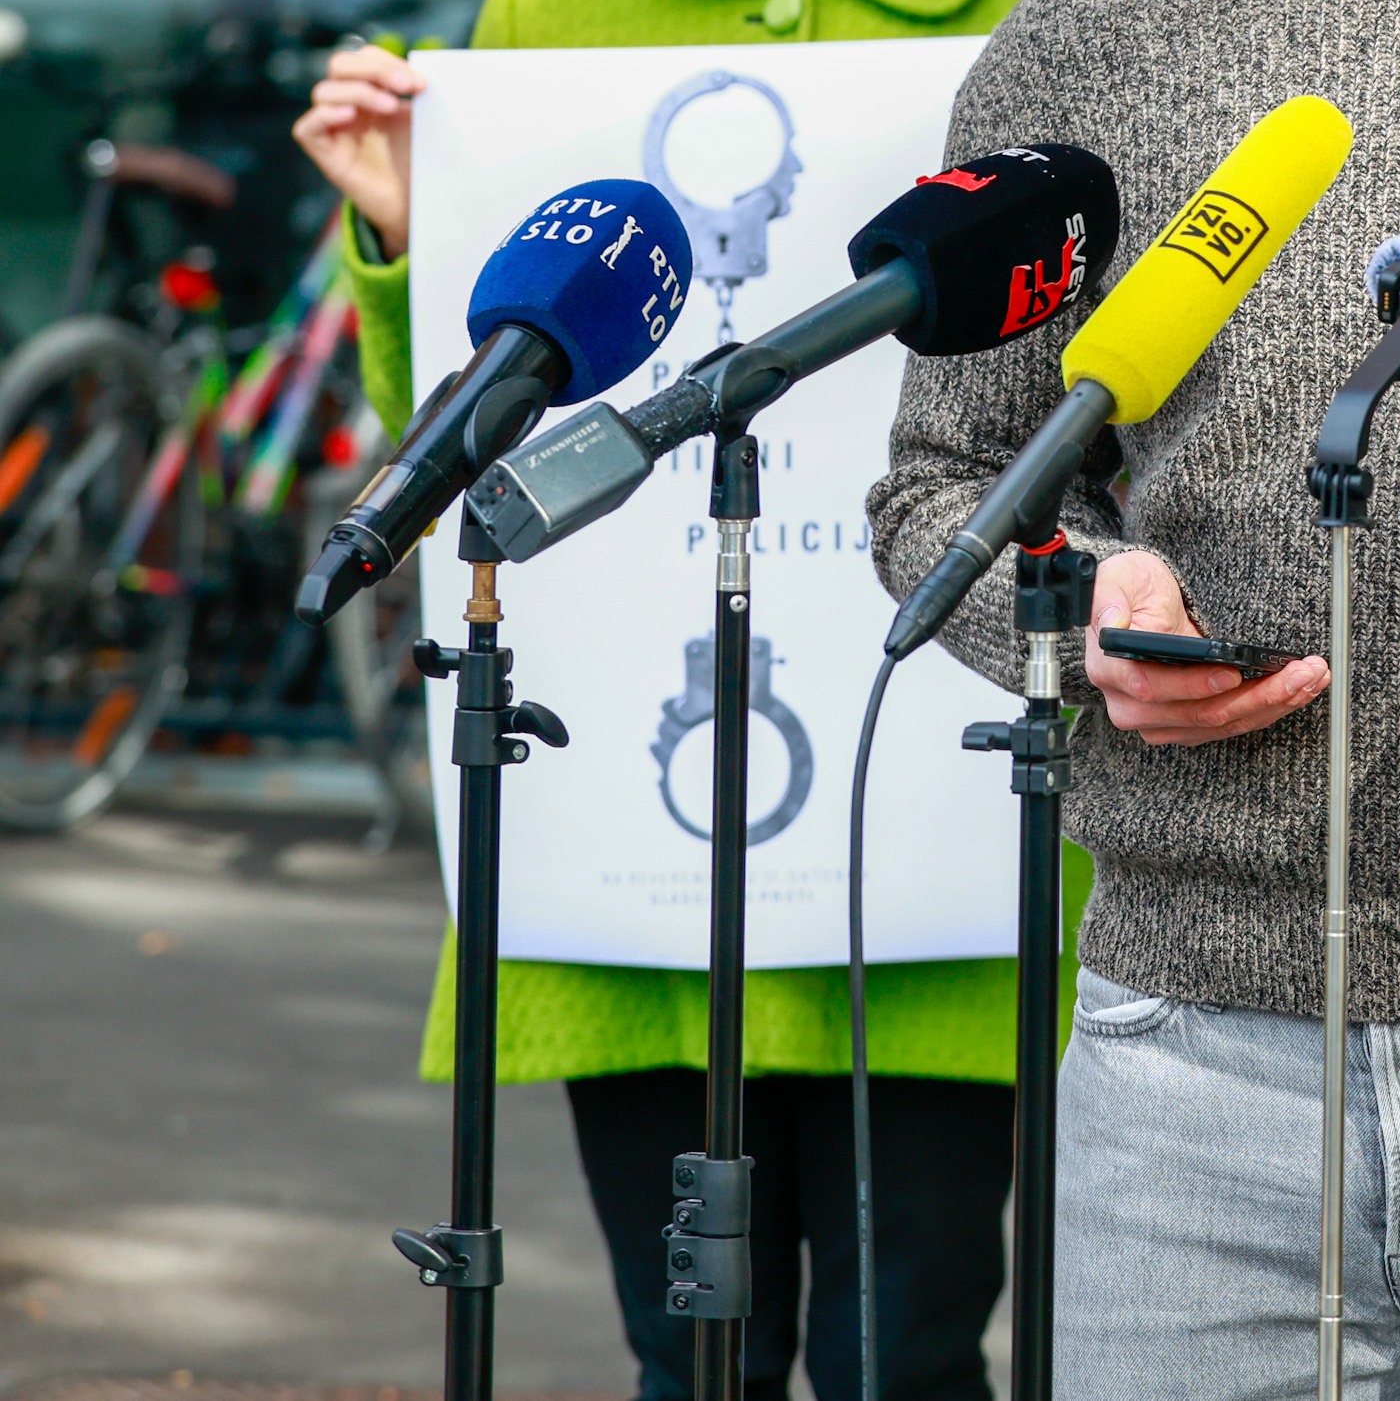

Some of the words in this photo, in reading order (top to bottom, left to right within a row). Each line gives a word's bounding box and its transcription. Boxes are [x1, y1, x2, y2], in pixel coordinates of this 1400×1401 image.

[542, 198, 617, 219] RTV
[1181, 203, 1227, 238] VZI
[520, 221, 593, 244] SLO
[1062, 212, 1087, 302] SVET
[649, 244, 683, 311] RTV
[539, 420, 601, 460] SENNHEISER
[687, 522, 868, 554] PLICIJ
